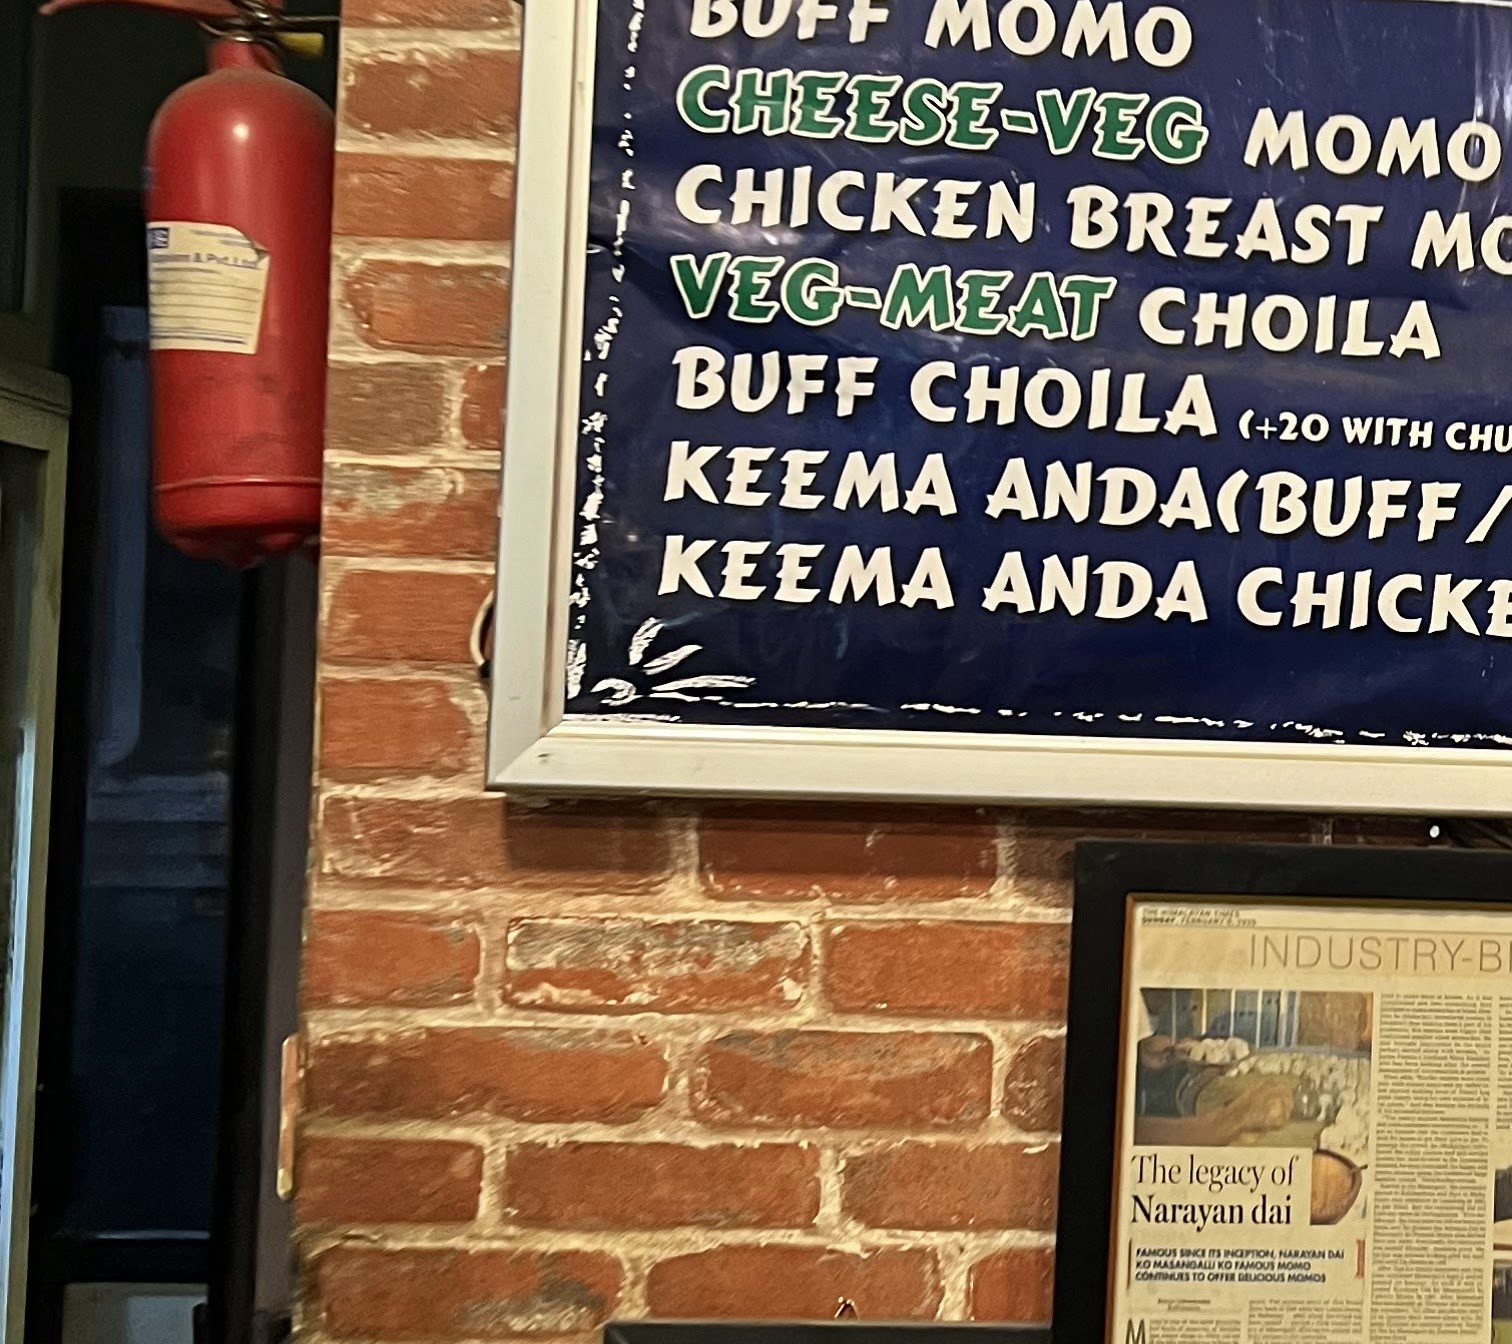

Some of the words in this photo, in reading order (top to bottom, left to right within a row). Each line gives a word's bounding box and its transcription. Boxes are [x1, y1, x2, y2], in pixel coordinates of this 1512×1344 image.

[676, 64, 1209, 165] CHEESE-VEG
[1243, 106, 1502, 183] MOMO
[675, 164, 1036, 244] CHICKEN
[1066, 183, 1384, 267] BREAST
[670, 252, 1117, 341] VEG-MEAT
[1138, 286, 1441, 361] CHOILA
[671, 345, 879, 418] BUFF
[910, 360, 1218, 437] CHOILA
[1237, 408, 1331, 445] (+20
[1341, 414, 1434, 450] WITH
[663, 440, 958, 517] KEEMA
[657, 533, 955, 611] KEEMA
[981, 550, 1209, 624] ANDA
[1130, 1154, 1182, 1184] The
[1189, 1154, 1265, 1194] legacy
[1271, 1155, 1300, 1186] of
[1131, 1194, 1244, 1233] Narayan
[1251, 1194, 1292, 1225] dai
[1135, 1259, 1151, 1269] KO
[1217, 1260, 1233, 1270] KO
[1234, 1260, 1275, 1271] FAMOUS
[1277, 1261, 1311, 1271] MOMO
[1135, 1272, 1190, 1282] CONTINUES
[1192, 1272, 1205, 1282] TO
[1207, 1273, 1236, 1283] OFFER
[1238, 1273, 1285, 1283] DELICIOUS
[1287, 1273, 1327, 1284] MOMOS
[1136, 1247, 1177, 1258] FAMOUS
[1179, 1248, 1209, 1259] SINCE
[1208, 1248, 1222, 1259] ITS
[1279, 1249, 1326, 1260] NARAYAN
[1328, 1249, 1345, 1260] DAI
